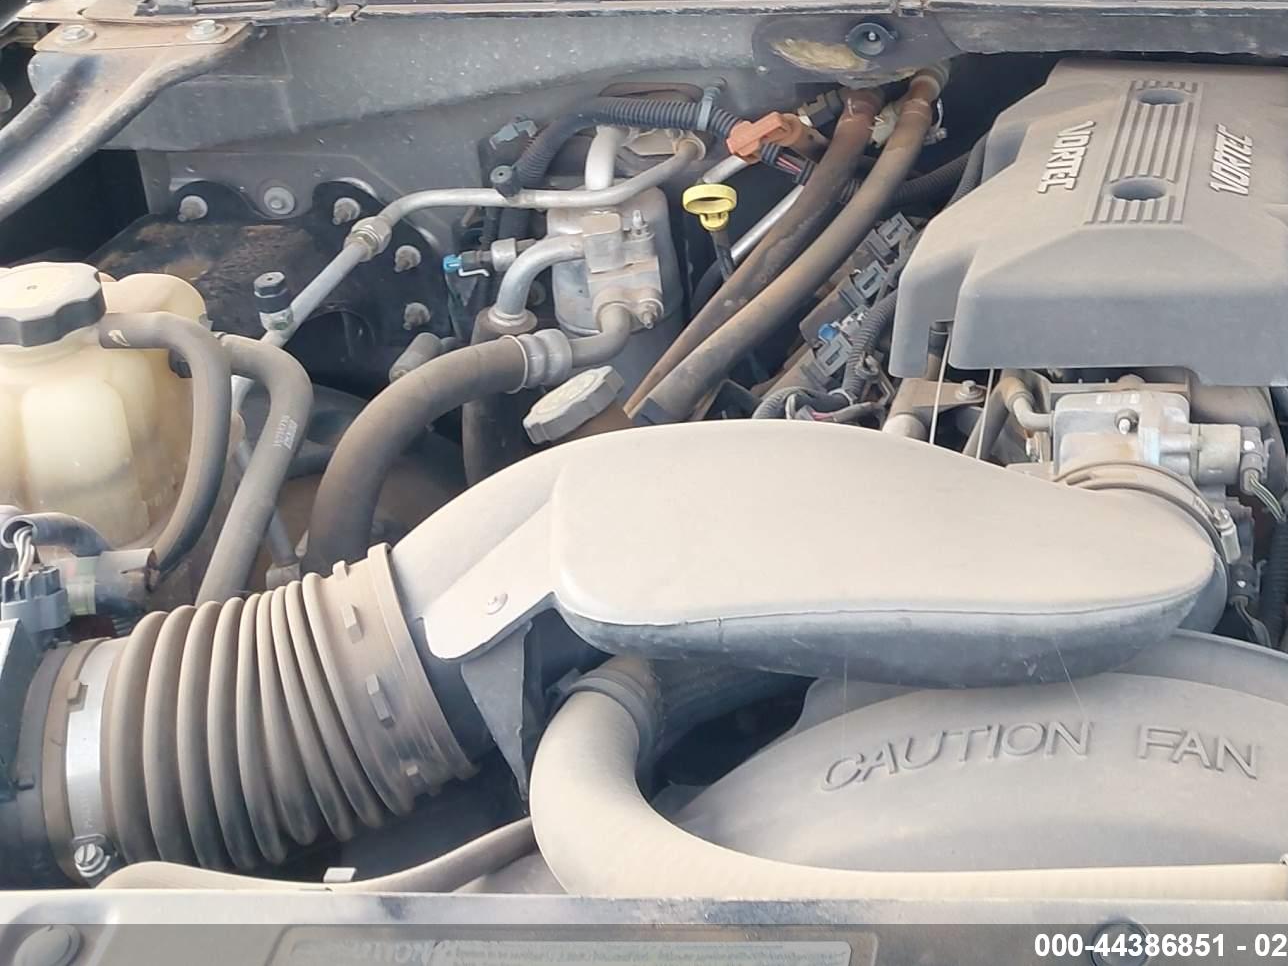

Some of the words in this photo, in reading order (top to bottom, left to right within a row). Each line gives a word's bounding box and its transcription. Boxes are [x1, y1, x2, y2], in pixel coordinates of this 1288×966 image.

[1037, 120, 1096, 194] VORTEC
[1208, 123, 1254, 196] VORTEC
[819, 718, 1091, 792] CAUTION
[1136, 723, 1260, 780] FAN
